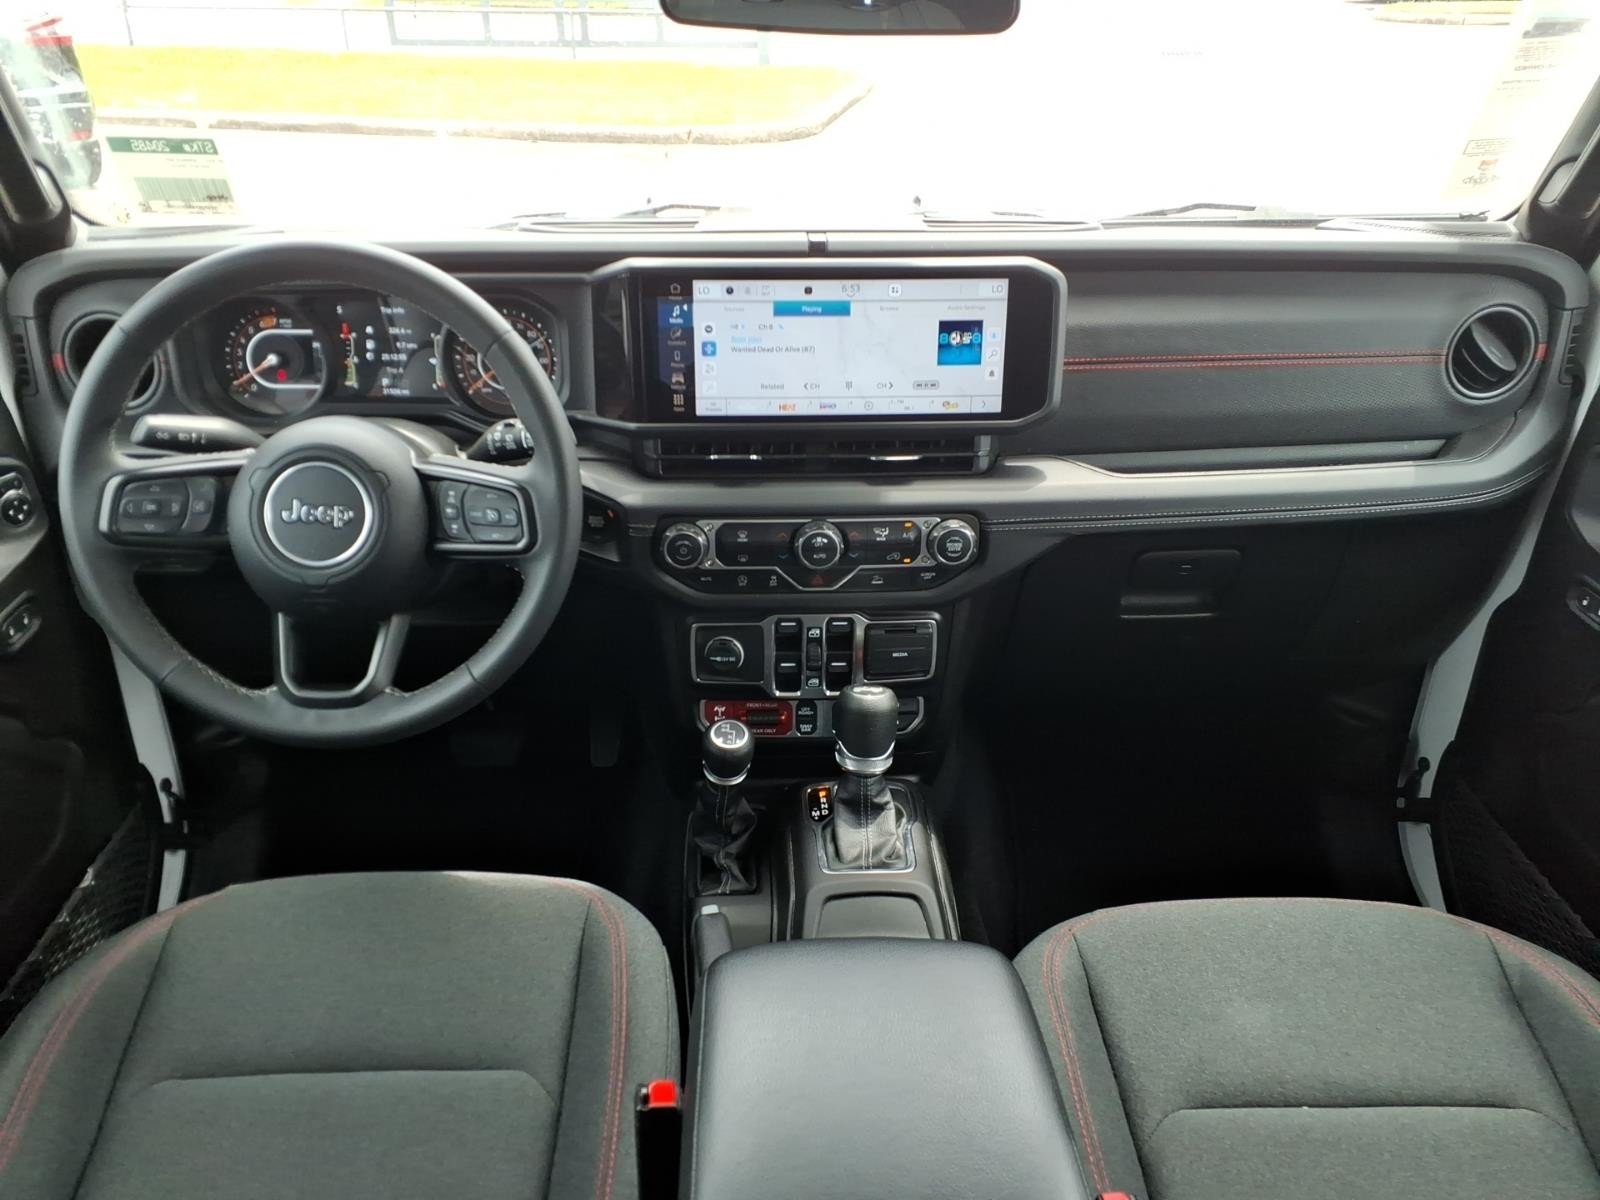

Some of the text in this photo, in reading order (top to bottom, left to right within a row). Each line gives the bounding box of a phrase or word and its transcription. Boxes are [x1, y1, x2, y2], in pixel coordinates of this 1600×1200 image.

[991, 285, 1004, 294] LO
[801, 305, 822, 314] Playing
[281, 498, 354, 528] Jeep
